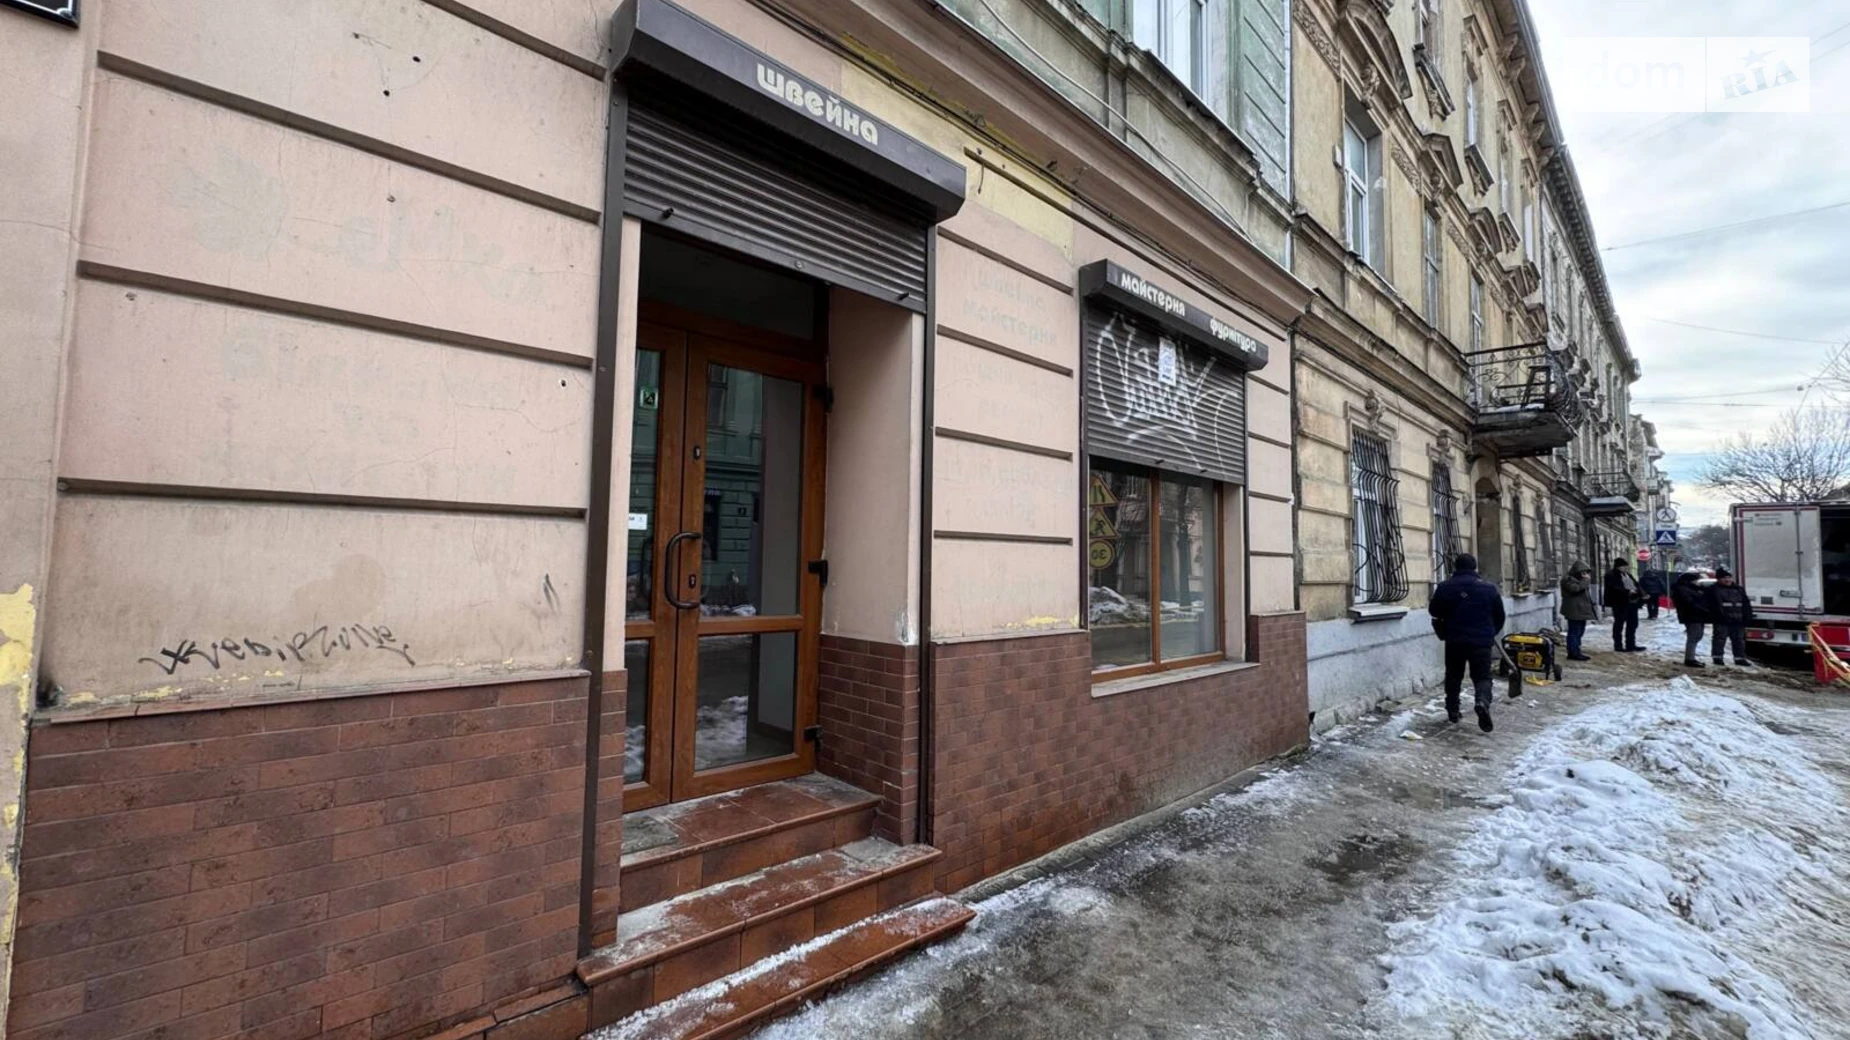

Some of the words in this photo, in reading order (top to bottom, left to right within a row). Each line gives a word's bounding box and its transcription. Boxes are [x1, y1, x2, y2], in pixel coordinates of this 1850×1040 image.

[757, 63, 878, 146] швейна
[1121, 273, 1185, 316] майстерня
[1209, 316, 1257, 352] фурнітура
